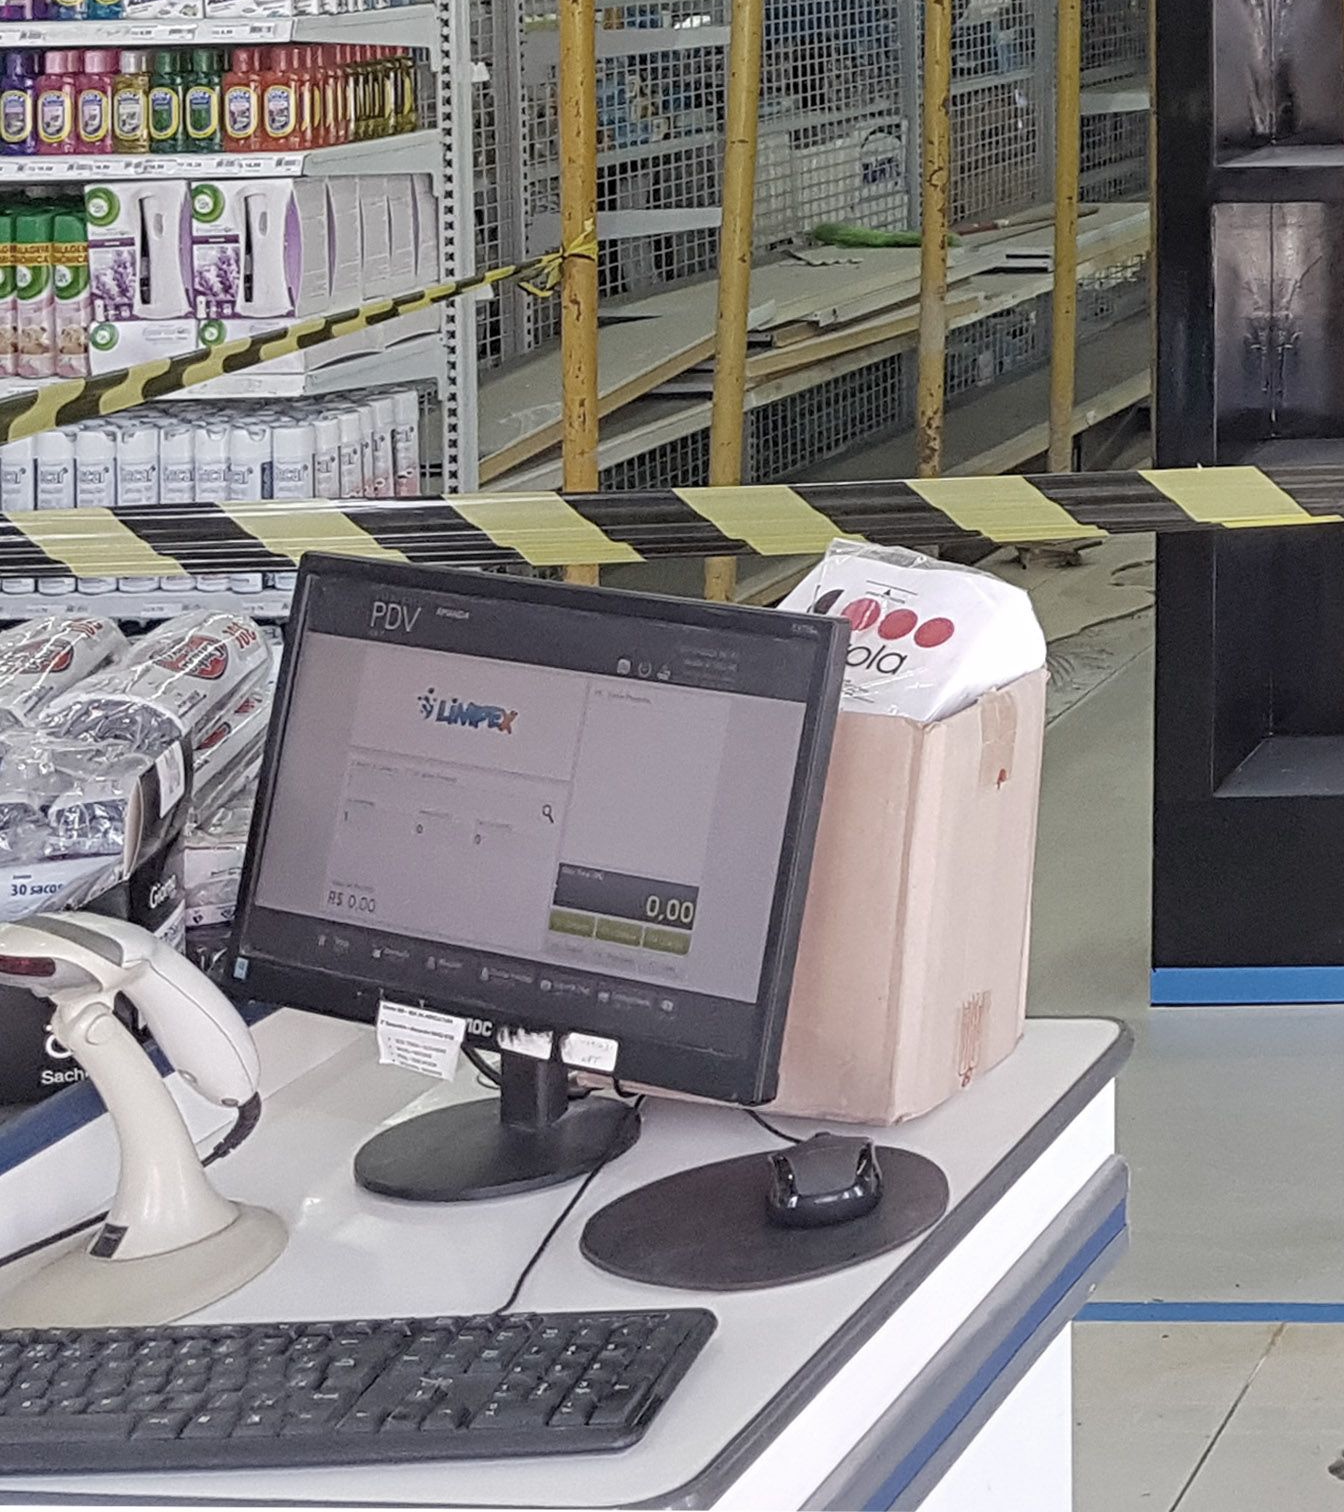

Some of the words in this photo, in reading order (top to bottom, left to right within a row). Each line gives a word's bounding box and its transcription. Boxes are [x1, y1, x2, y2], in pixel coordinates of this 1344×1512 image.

[370, 601, 422, 632] PDV
[845, 645, 908, 675] ola
[11, 884, 27, 897] 30
[348, 895, 376, 913] 0,00
[645, 895, 694, 923] 0,00
[41, 1068, 89, 1085] Sach
